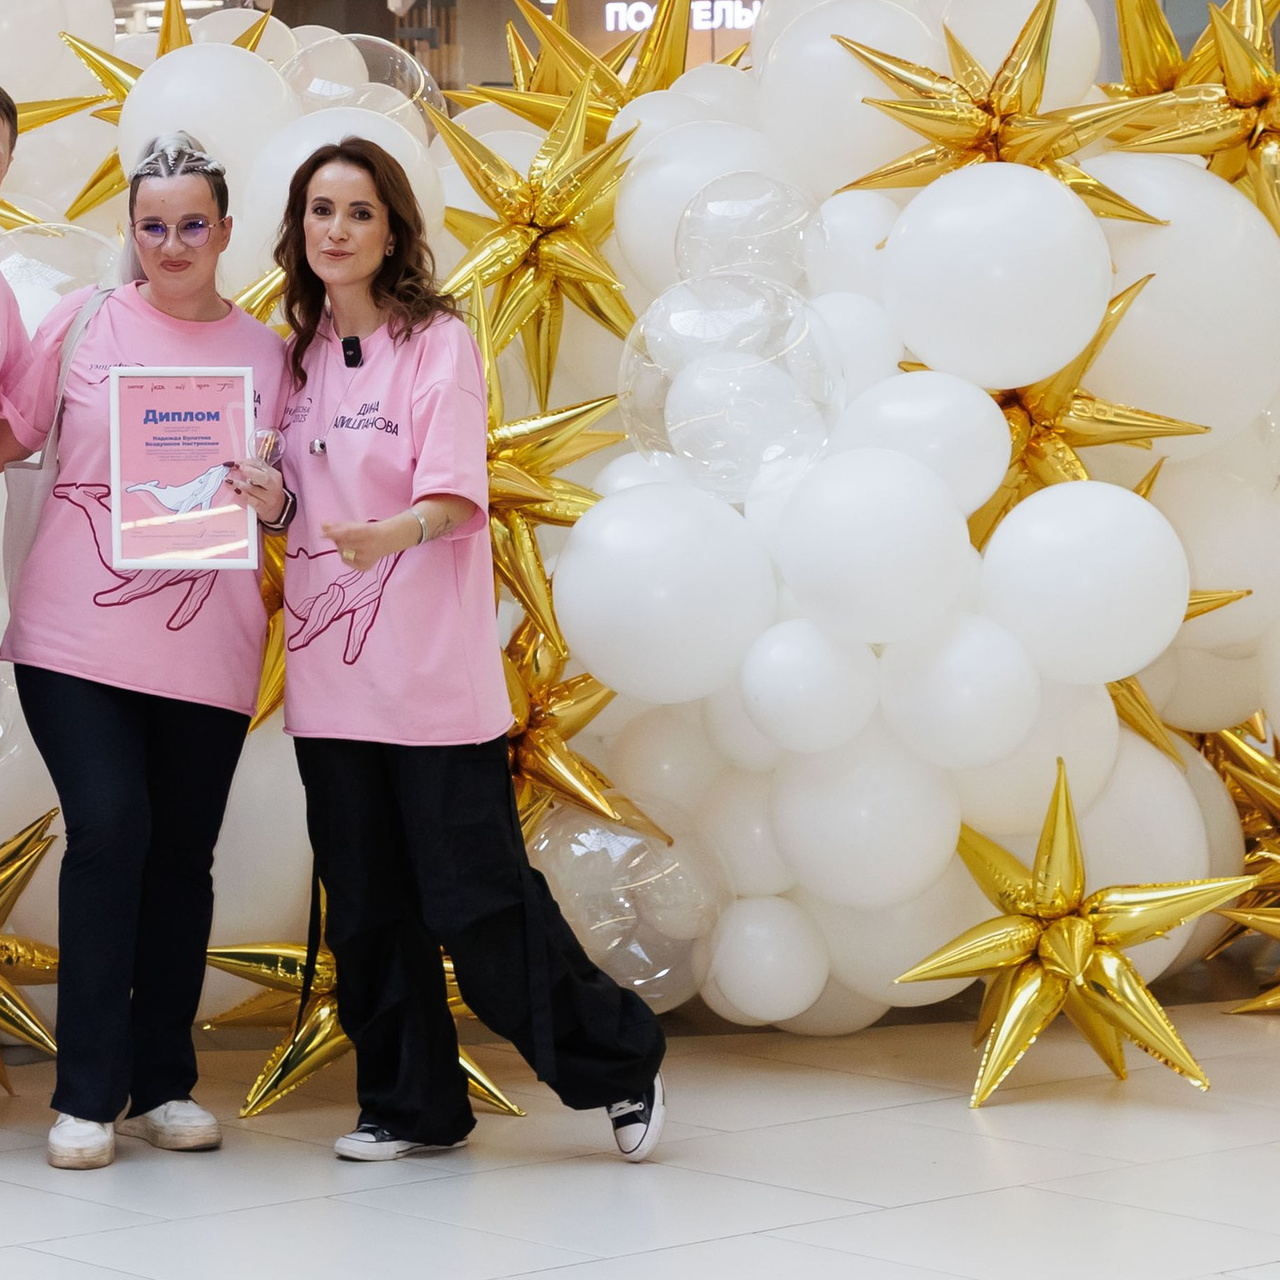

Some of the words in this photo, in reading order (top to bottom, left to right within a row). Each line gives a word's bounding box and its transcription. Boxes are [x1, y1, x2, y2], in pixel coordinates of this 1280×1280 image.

[605, 0, 762, 32] ПОЕЛЬ
[357, 400, 380, 416] ДИНА
[143, 409, 220, 425] Диплом
